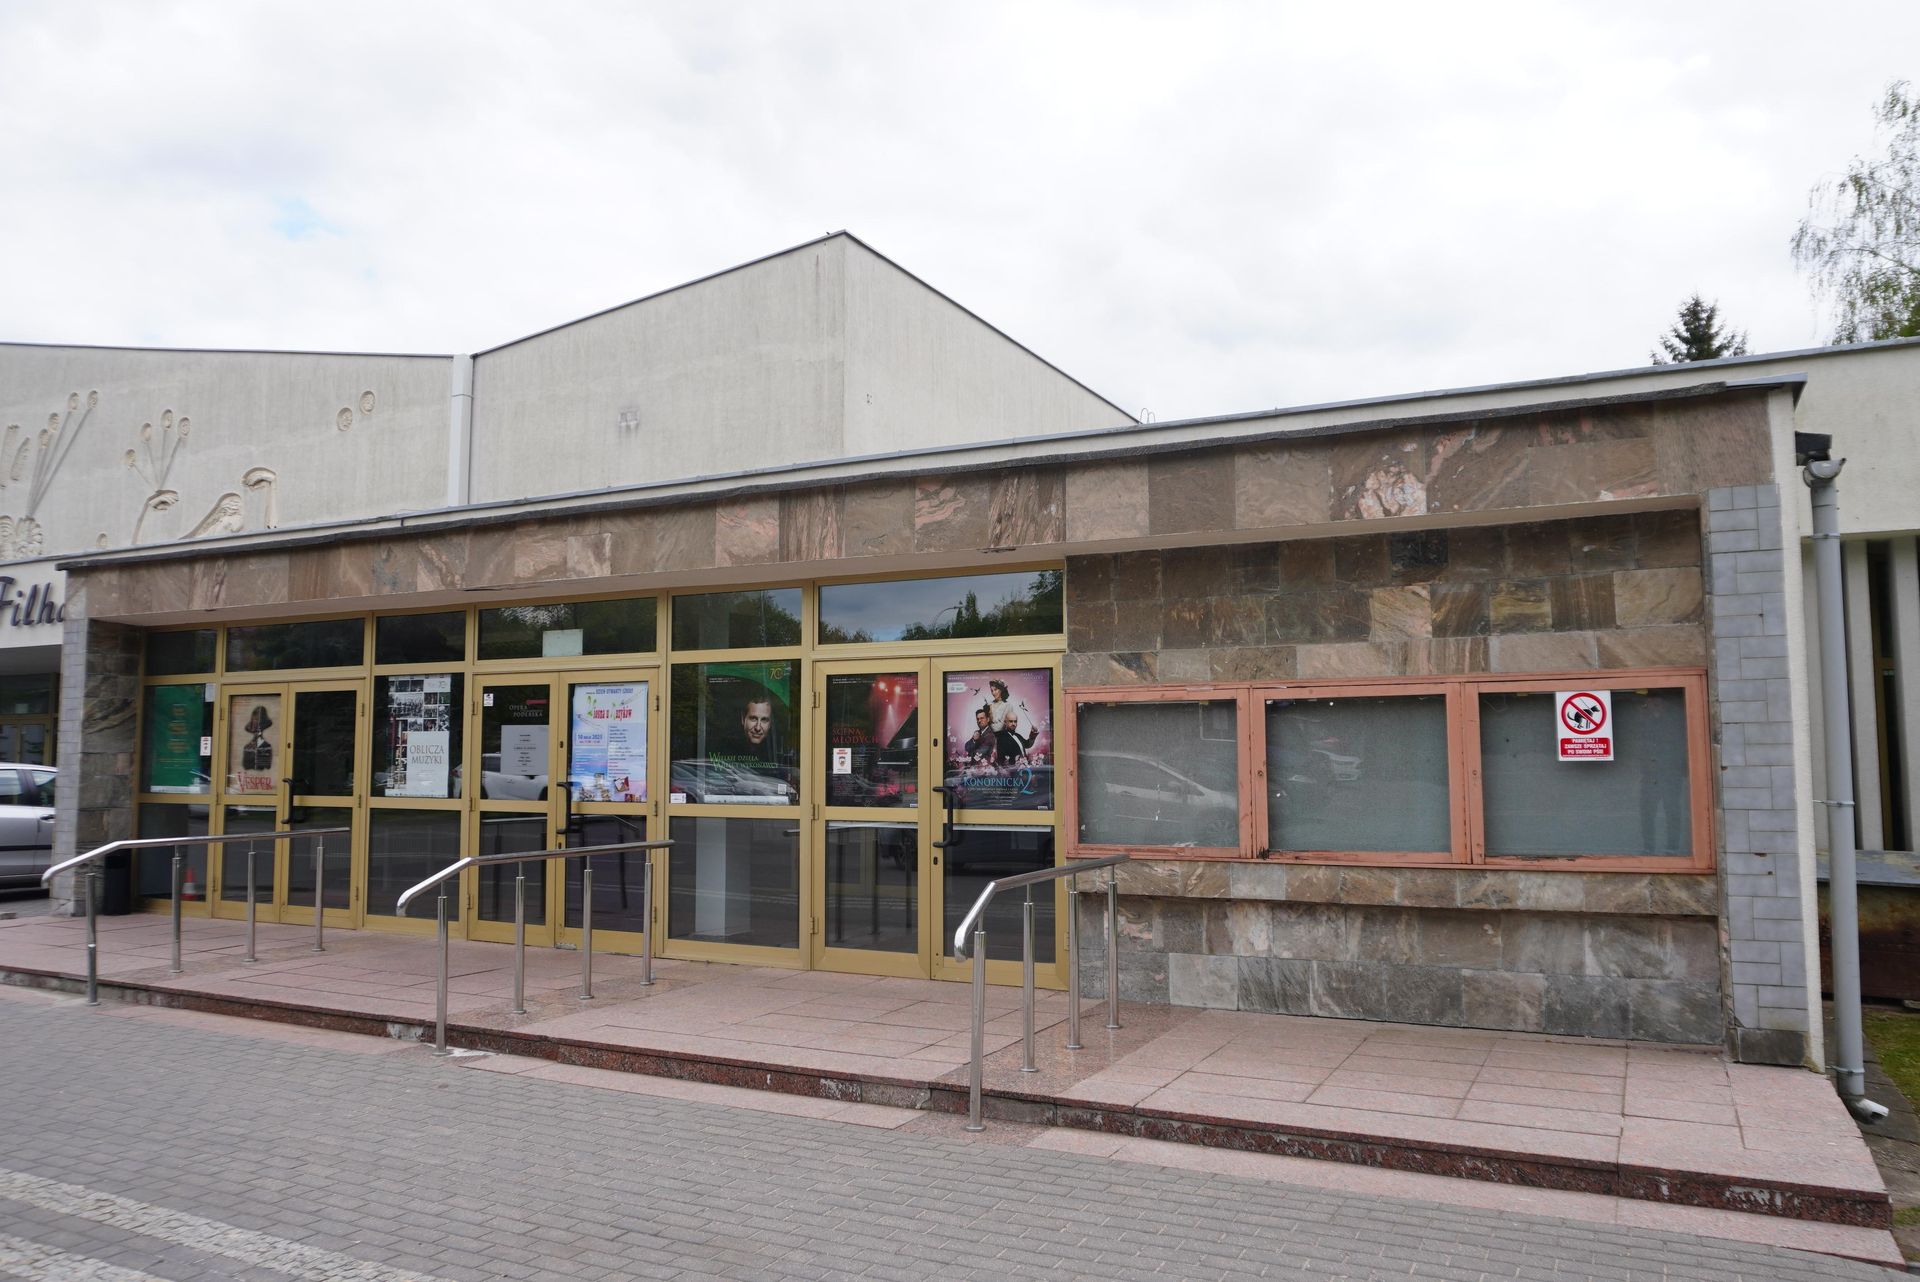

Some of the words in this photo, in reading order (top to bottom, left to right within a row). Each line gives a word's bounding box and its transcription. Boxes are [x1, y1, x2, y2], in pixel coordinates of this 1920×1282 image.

[409, 744, 444, 754] OBLICZA
[411, 756, 442, 765] MUZYKI
[237, 771, 273, 793] VESPER
[963, 777, 1025, 787] KONOPNICKA
[1018, 767, 1038, 795] 2
